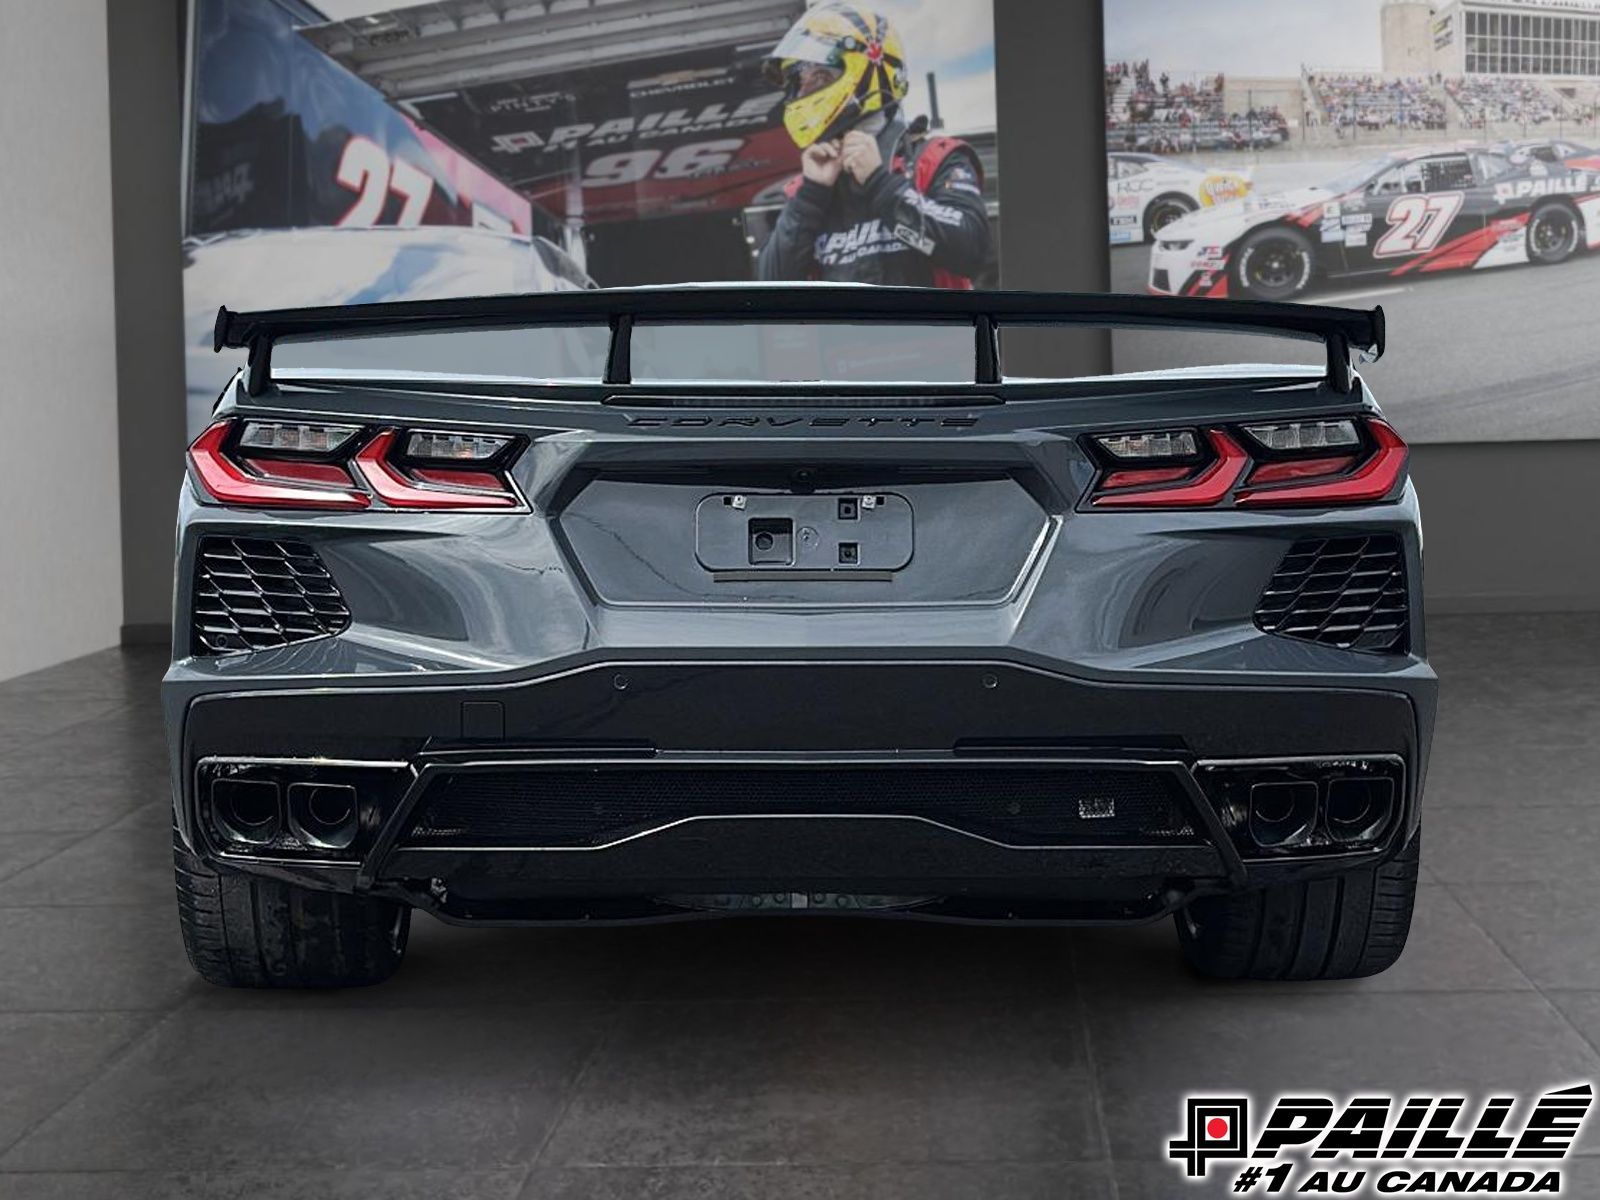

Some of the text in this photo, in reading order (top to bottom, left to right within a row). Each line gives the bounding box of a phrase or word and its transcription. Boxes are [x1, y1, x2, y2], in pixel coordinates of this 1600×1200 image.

[334, 134, 434, 228] 27
[1373, 190, 1465, 259] 27
[627, 416, 980, 428] CORVETTE
